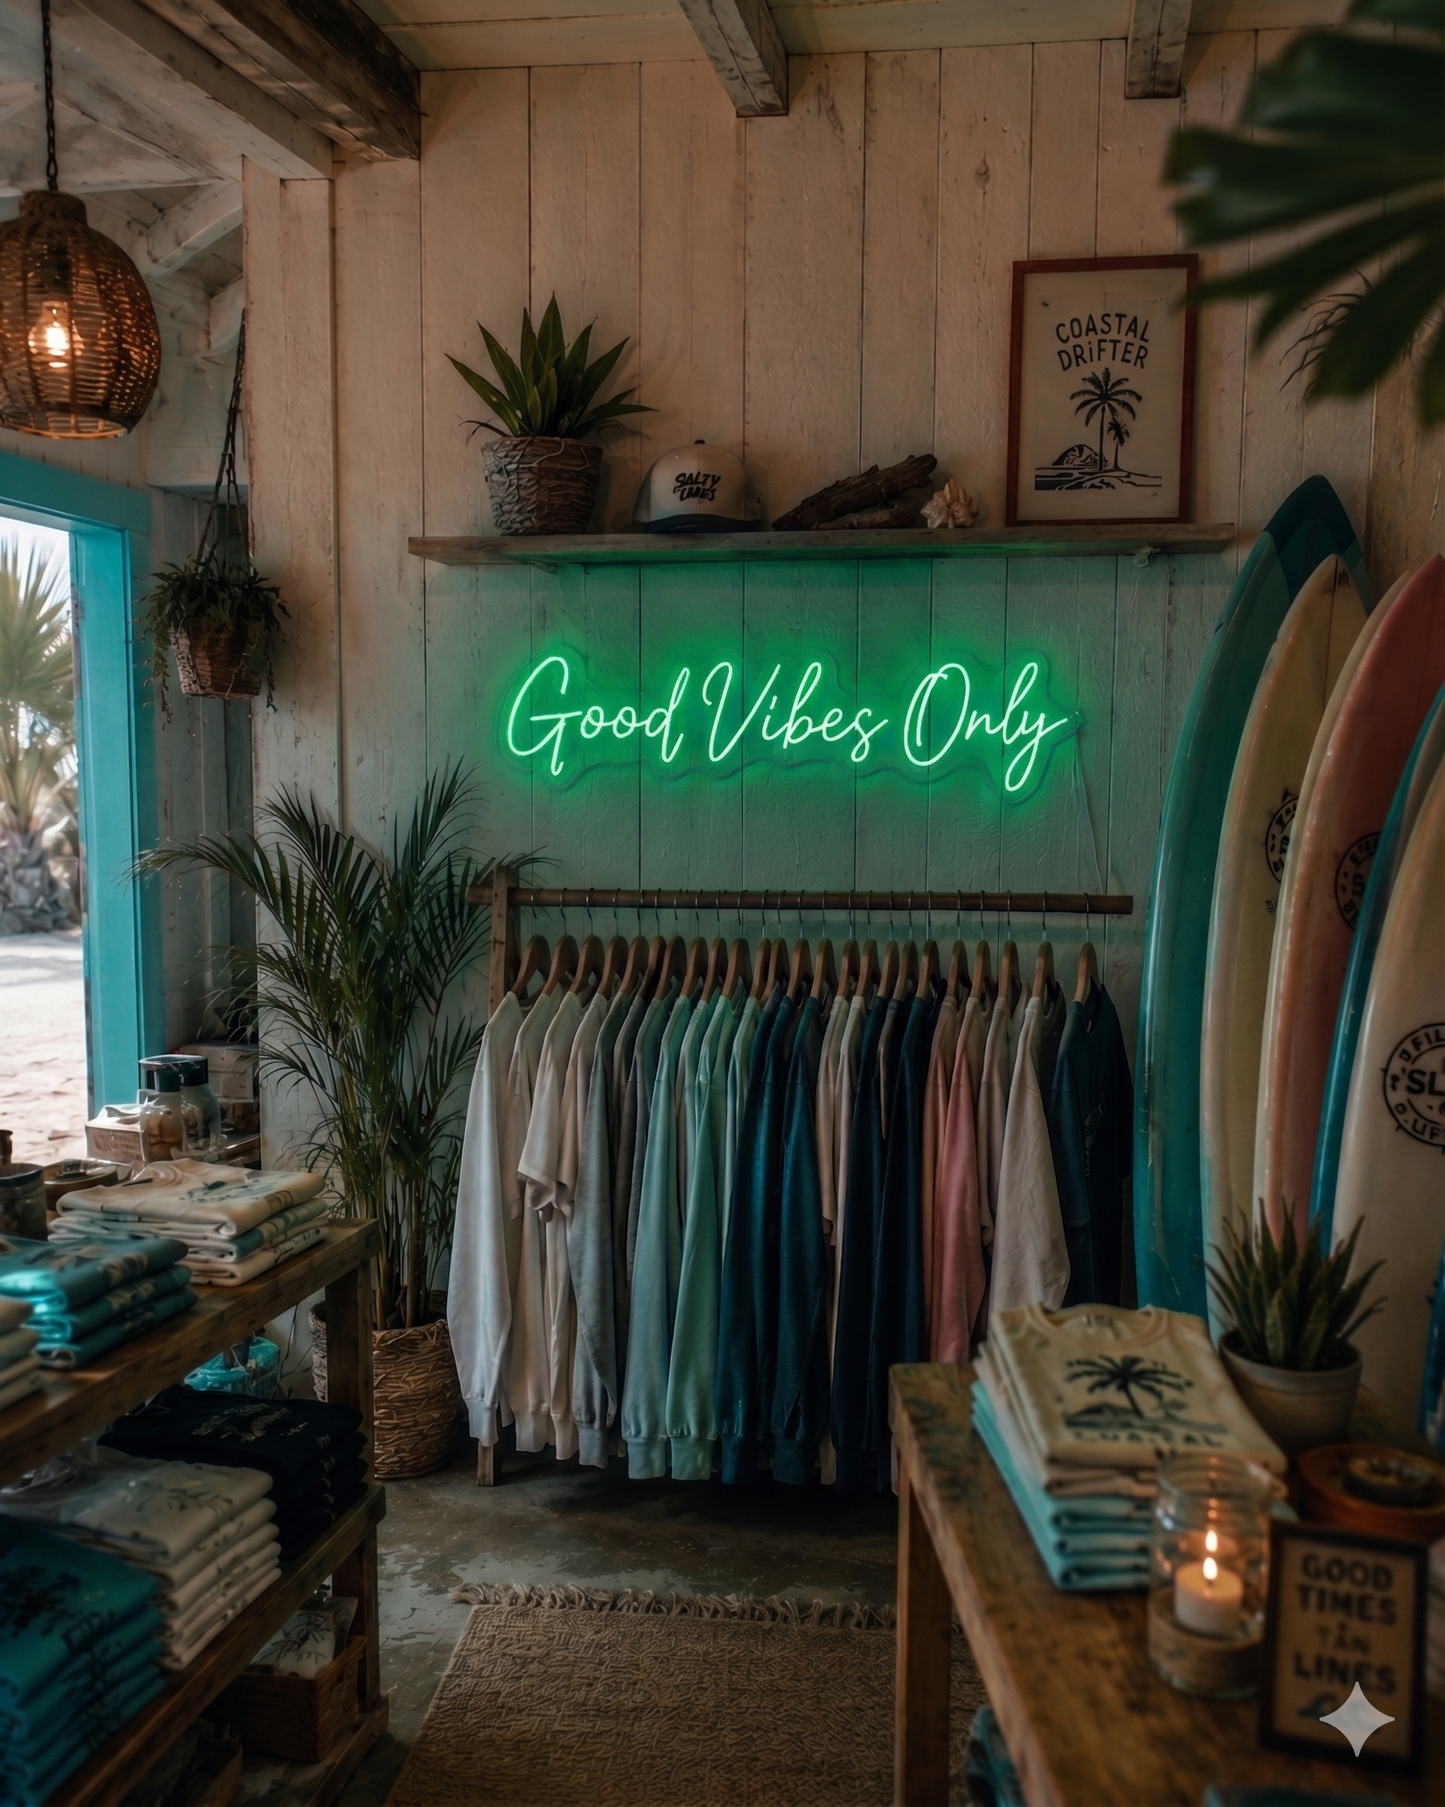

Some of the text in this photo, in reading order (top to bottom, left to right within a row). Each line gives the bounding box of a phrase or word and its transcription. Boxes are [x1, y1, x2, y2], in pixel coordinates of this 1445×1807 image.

[1055, 312, 1149, 344] COASTAL
[674, 471, 721, 491] SALTY
[507, 655, 1068, 792] Good Vibes Only
[1302, 1554, 1393, 1592] GOOD
[1296, 1583, 1397, 1626] TIMES
[1293, 1653, 1397, 1696] LINES
